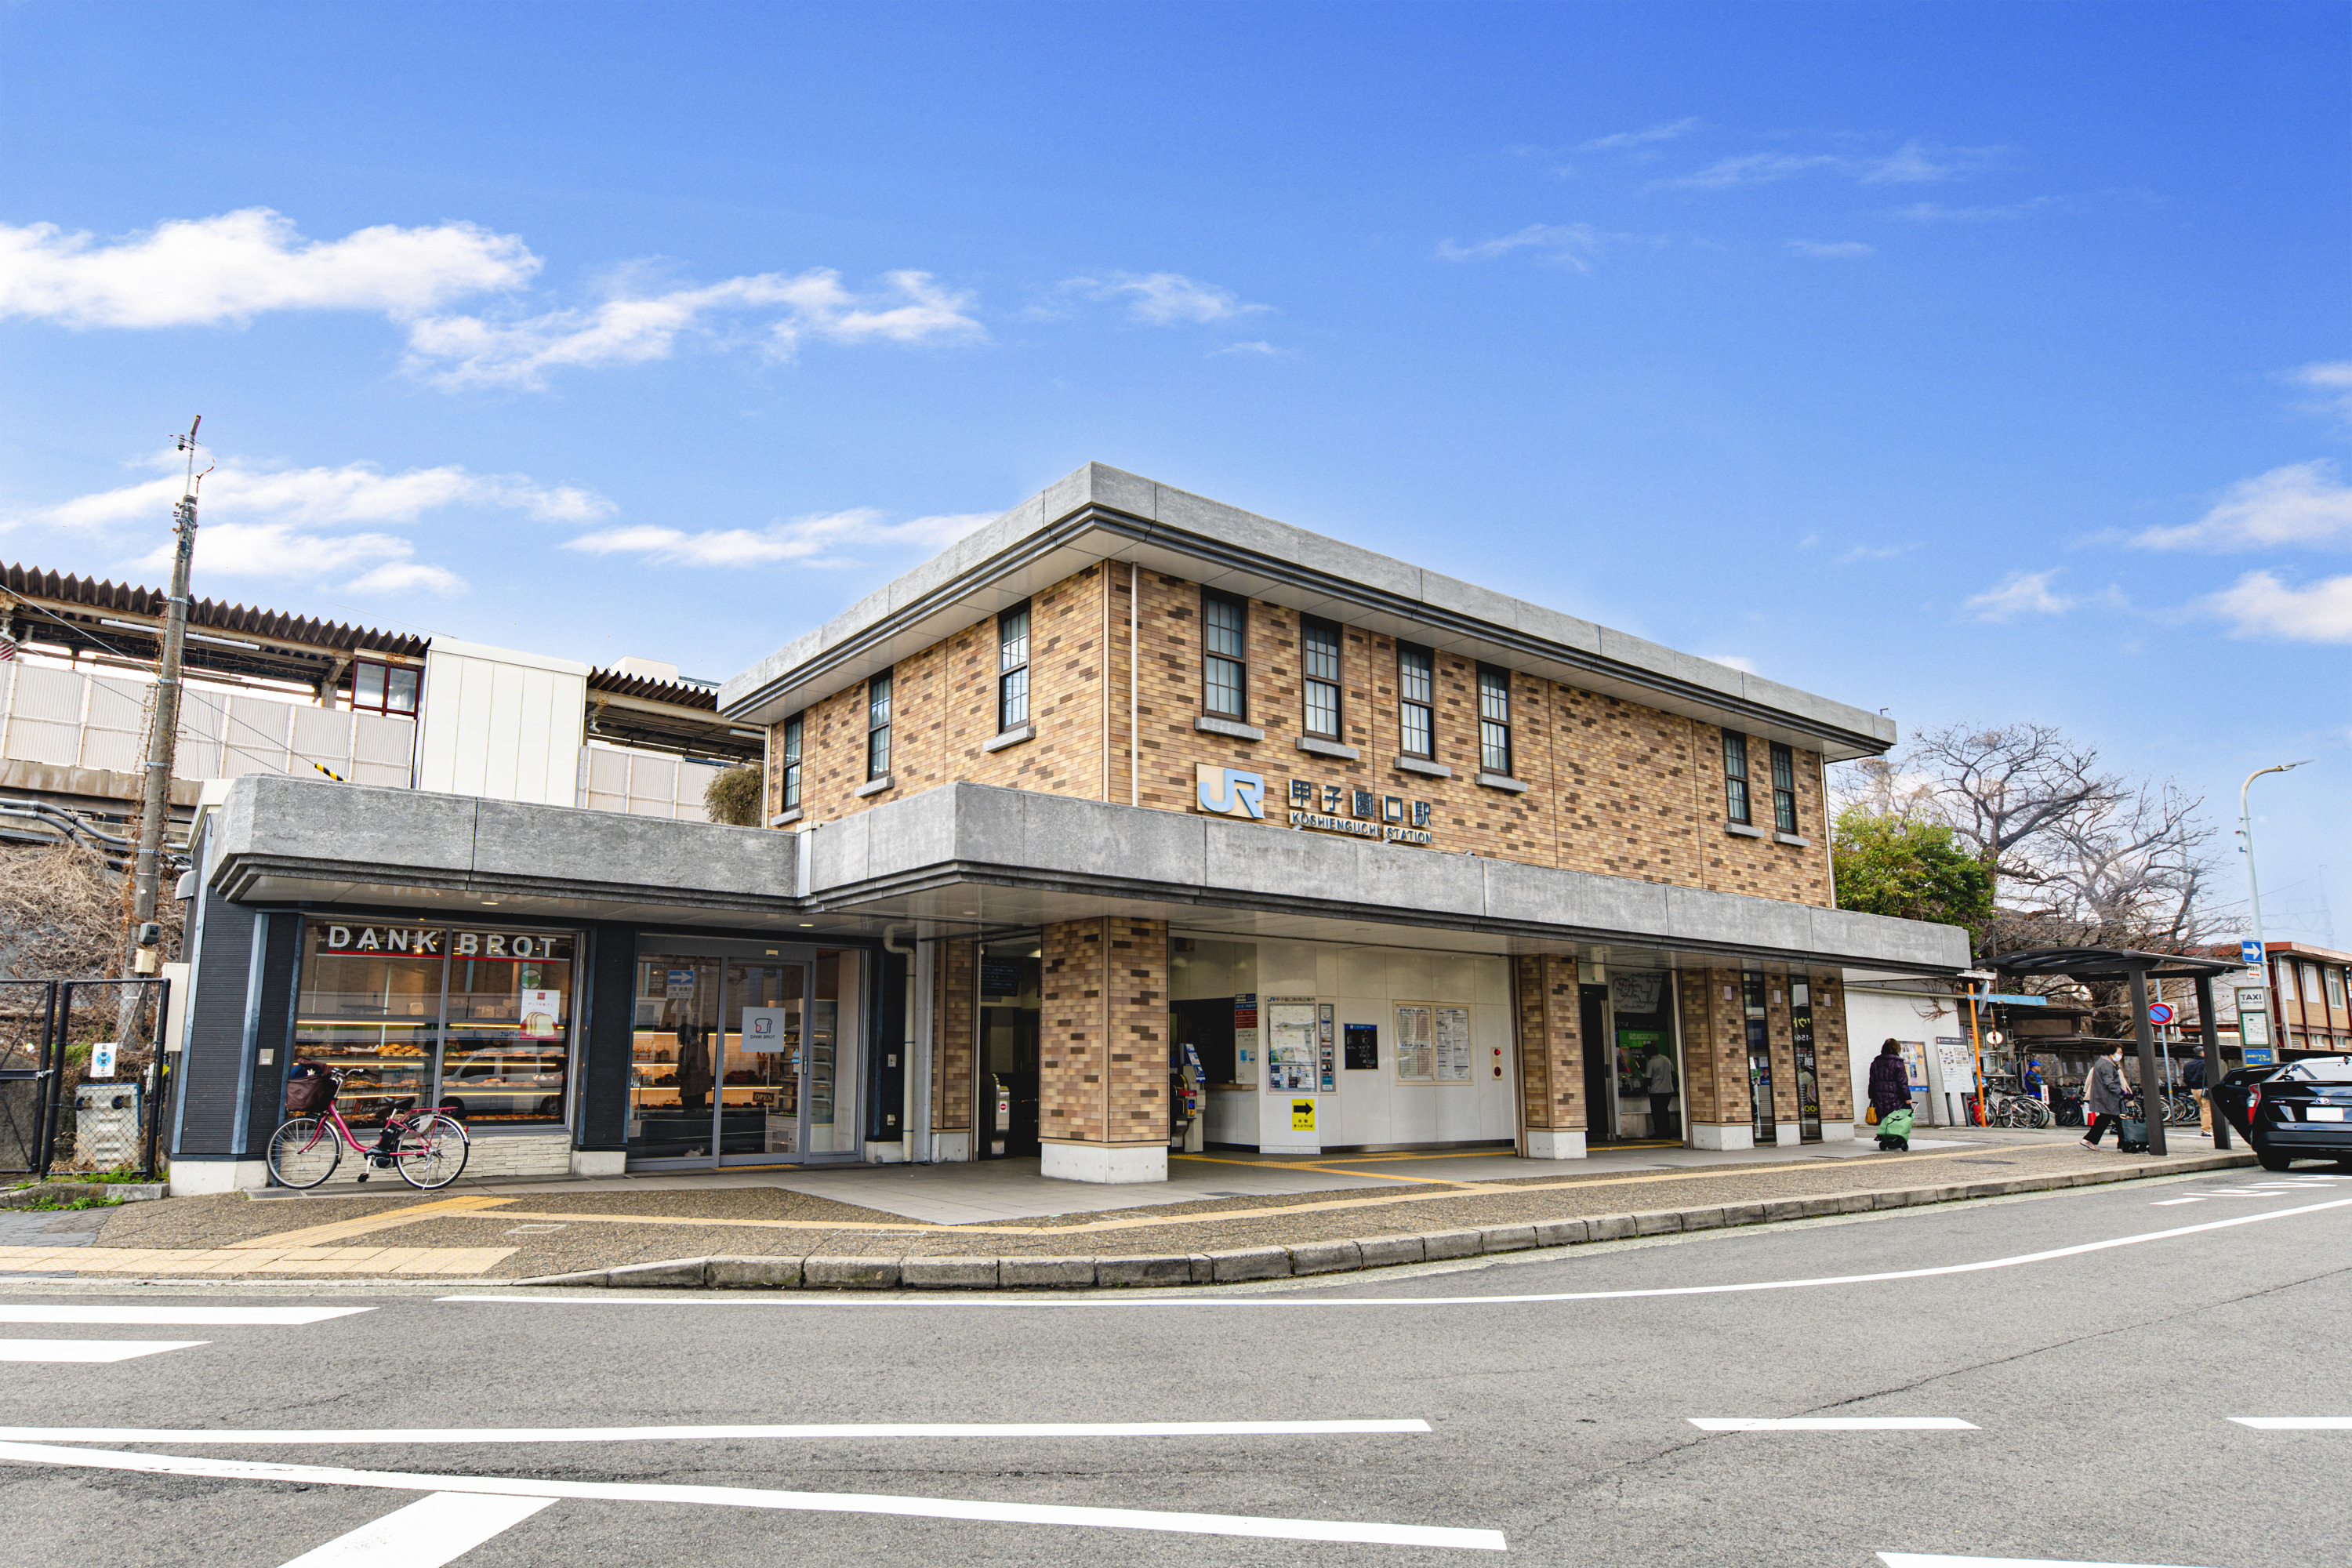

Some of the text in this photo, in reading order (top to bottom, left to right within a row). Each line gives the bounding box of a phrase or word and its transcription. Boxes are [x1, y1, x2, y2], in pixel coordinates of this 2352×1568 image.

[1198, 768, 1265, 819] JR
[1290, 779, 1432, 827] 甲子園口駅
[1385, 827, 1432, 844] STATION
[328, 926, 557, 957] DANK BROT
